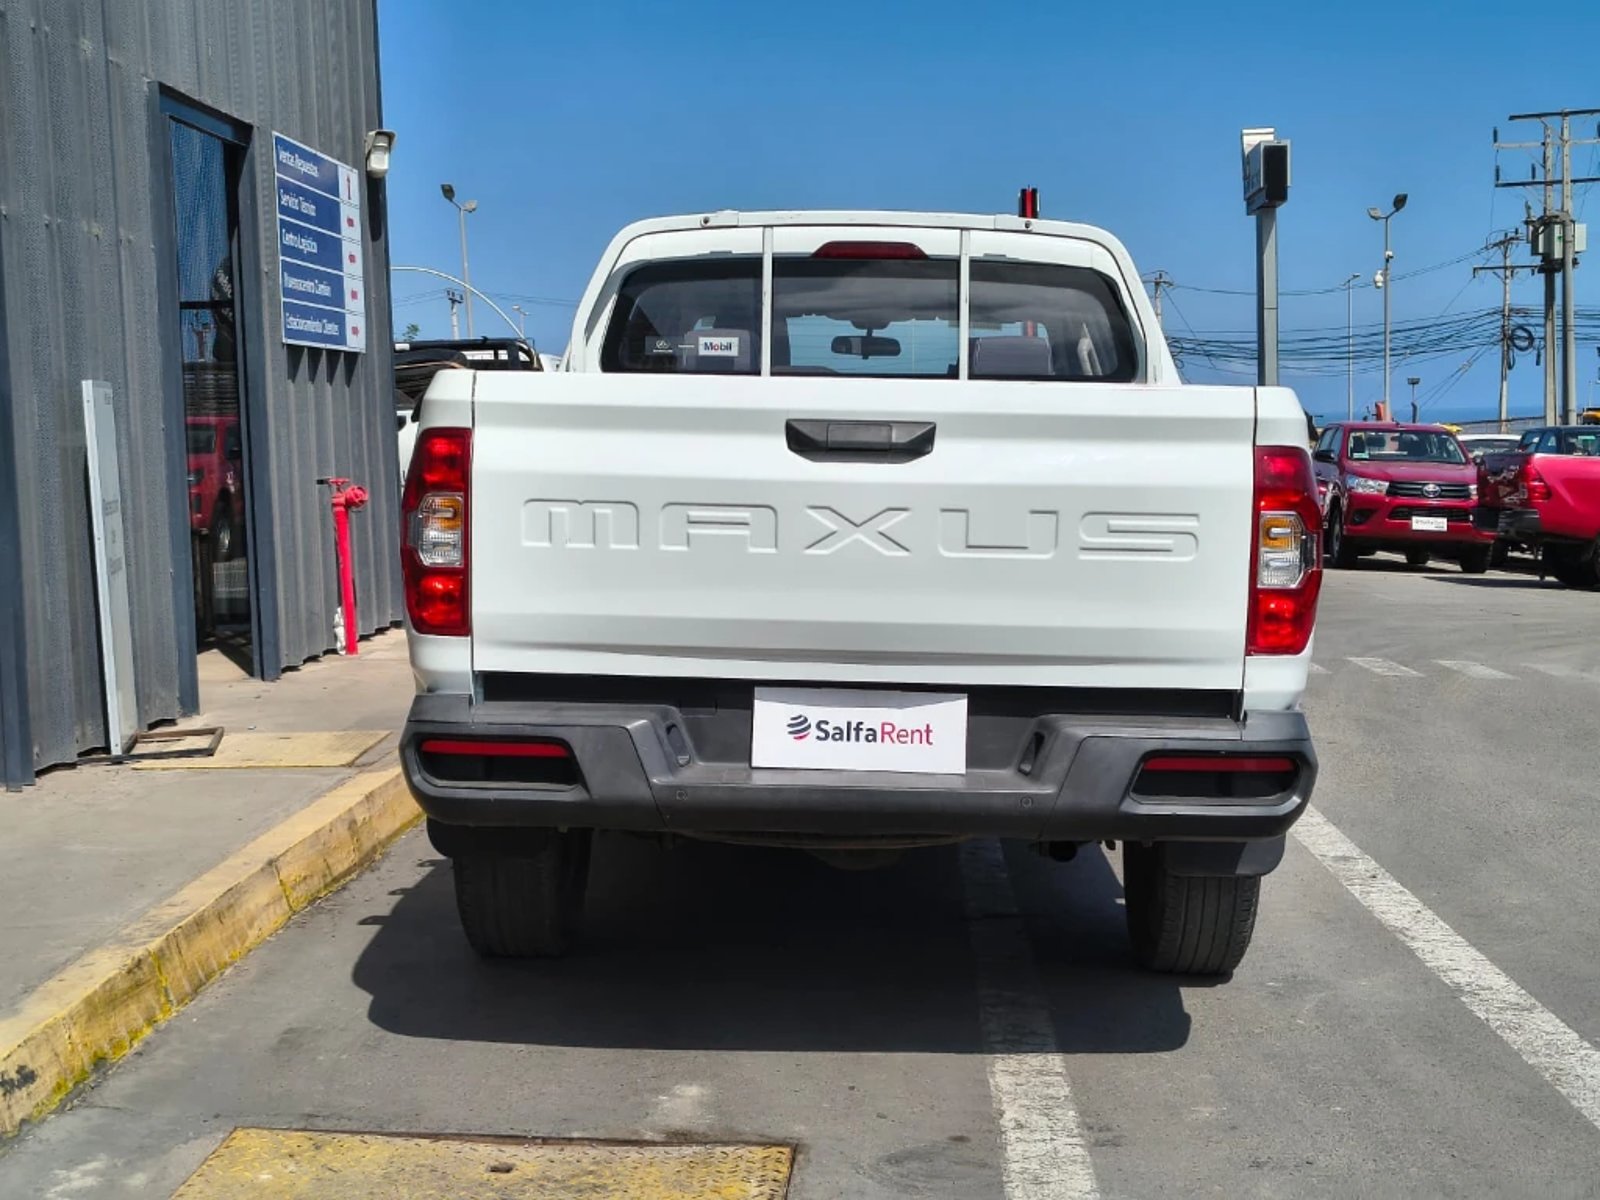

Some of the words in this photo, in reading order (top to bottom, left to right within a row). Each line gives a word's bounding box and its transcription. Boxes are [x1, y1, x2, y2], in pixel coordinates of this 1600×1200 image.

[280, 188, 299, 210] Servicio
[282, 228, 299, 248] Centro
[704, 342, 732, 352] Mobil
[521, 498, 1200, 562] MAXUS
[815, 718, 934, 746] SalfaRent
